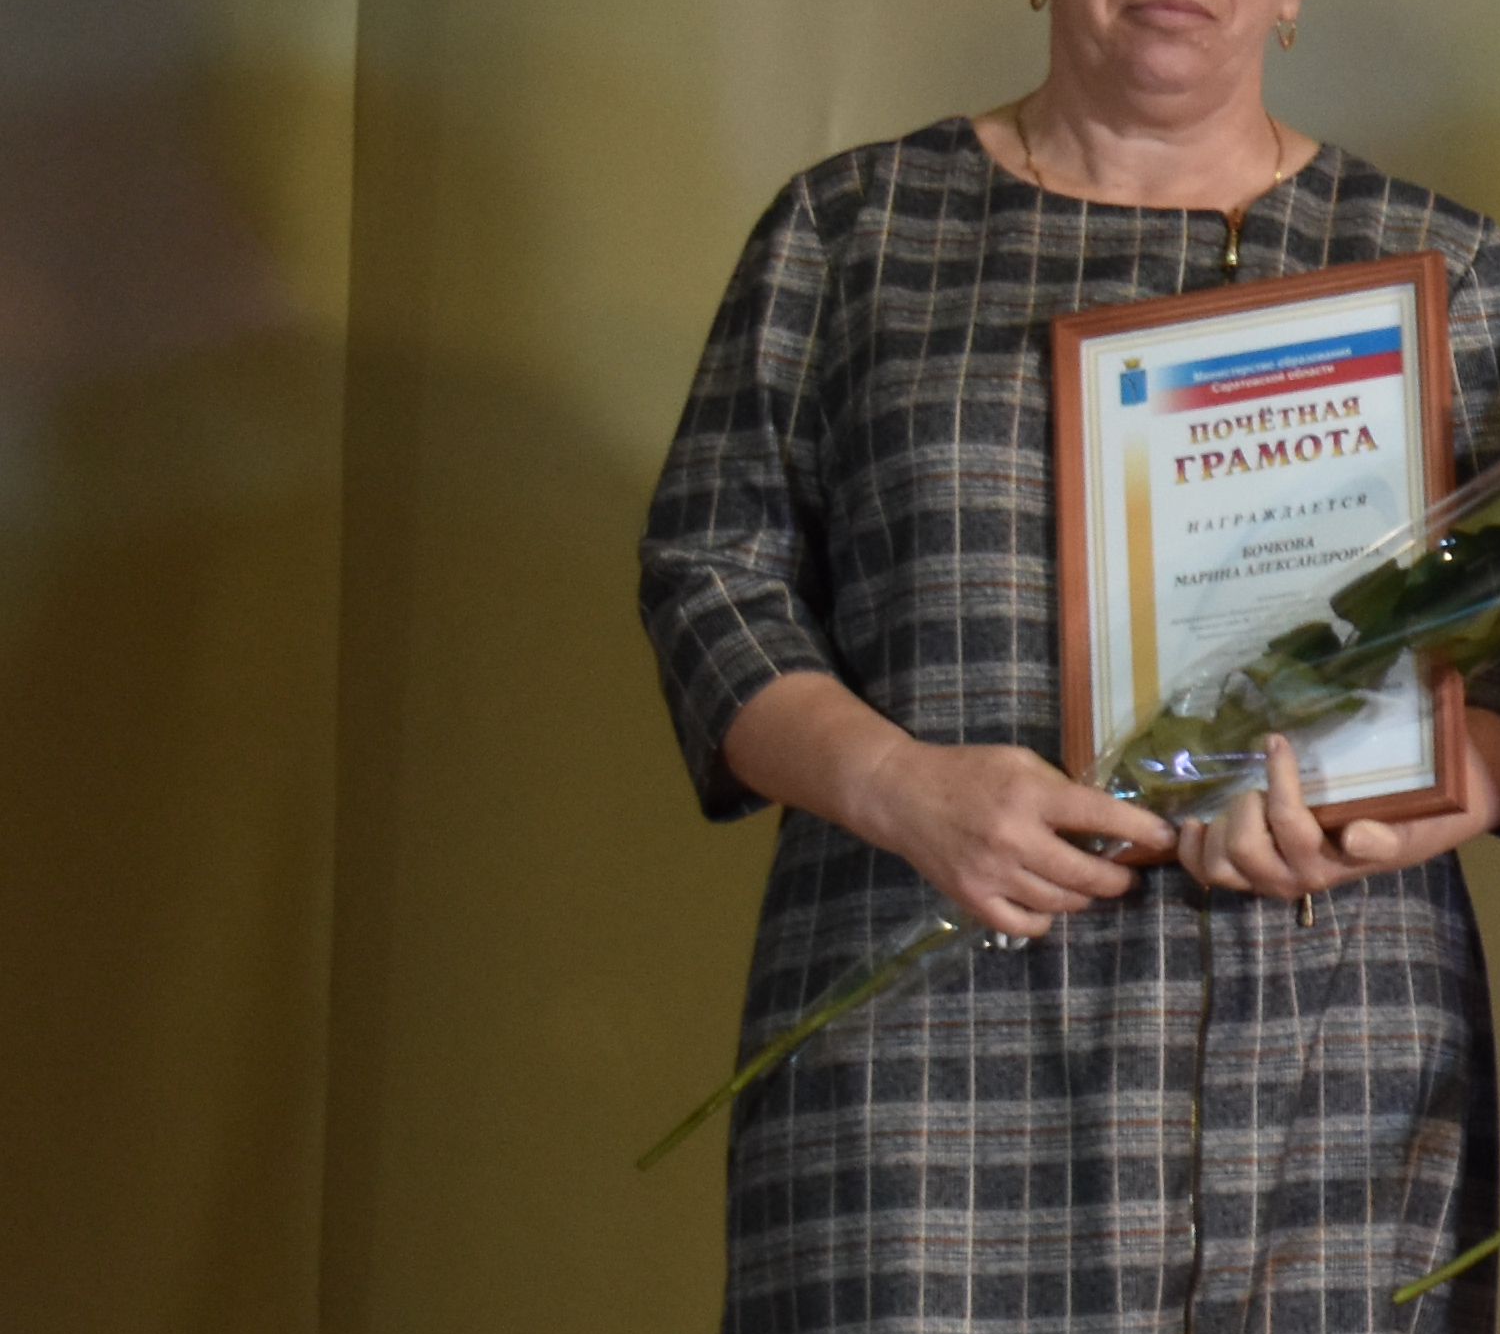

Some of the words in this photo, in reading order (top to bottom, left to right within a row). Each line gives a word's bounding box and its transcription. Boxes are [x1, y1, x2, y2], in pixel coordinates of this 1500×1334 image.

[1189, 395, 1361, 445] ПОЧЁТНАЯ
[1174, 423, 1379, 485] ГРАМОТА
[1187, 493, 1368, 534] НАГРАЖДАЕТСЯ
[1174, 567, 1241, 587] МАРИНА
